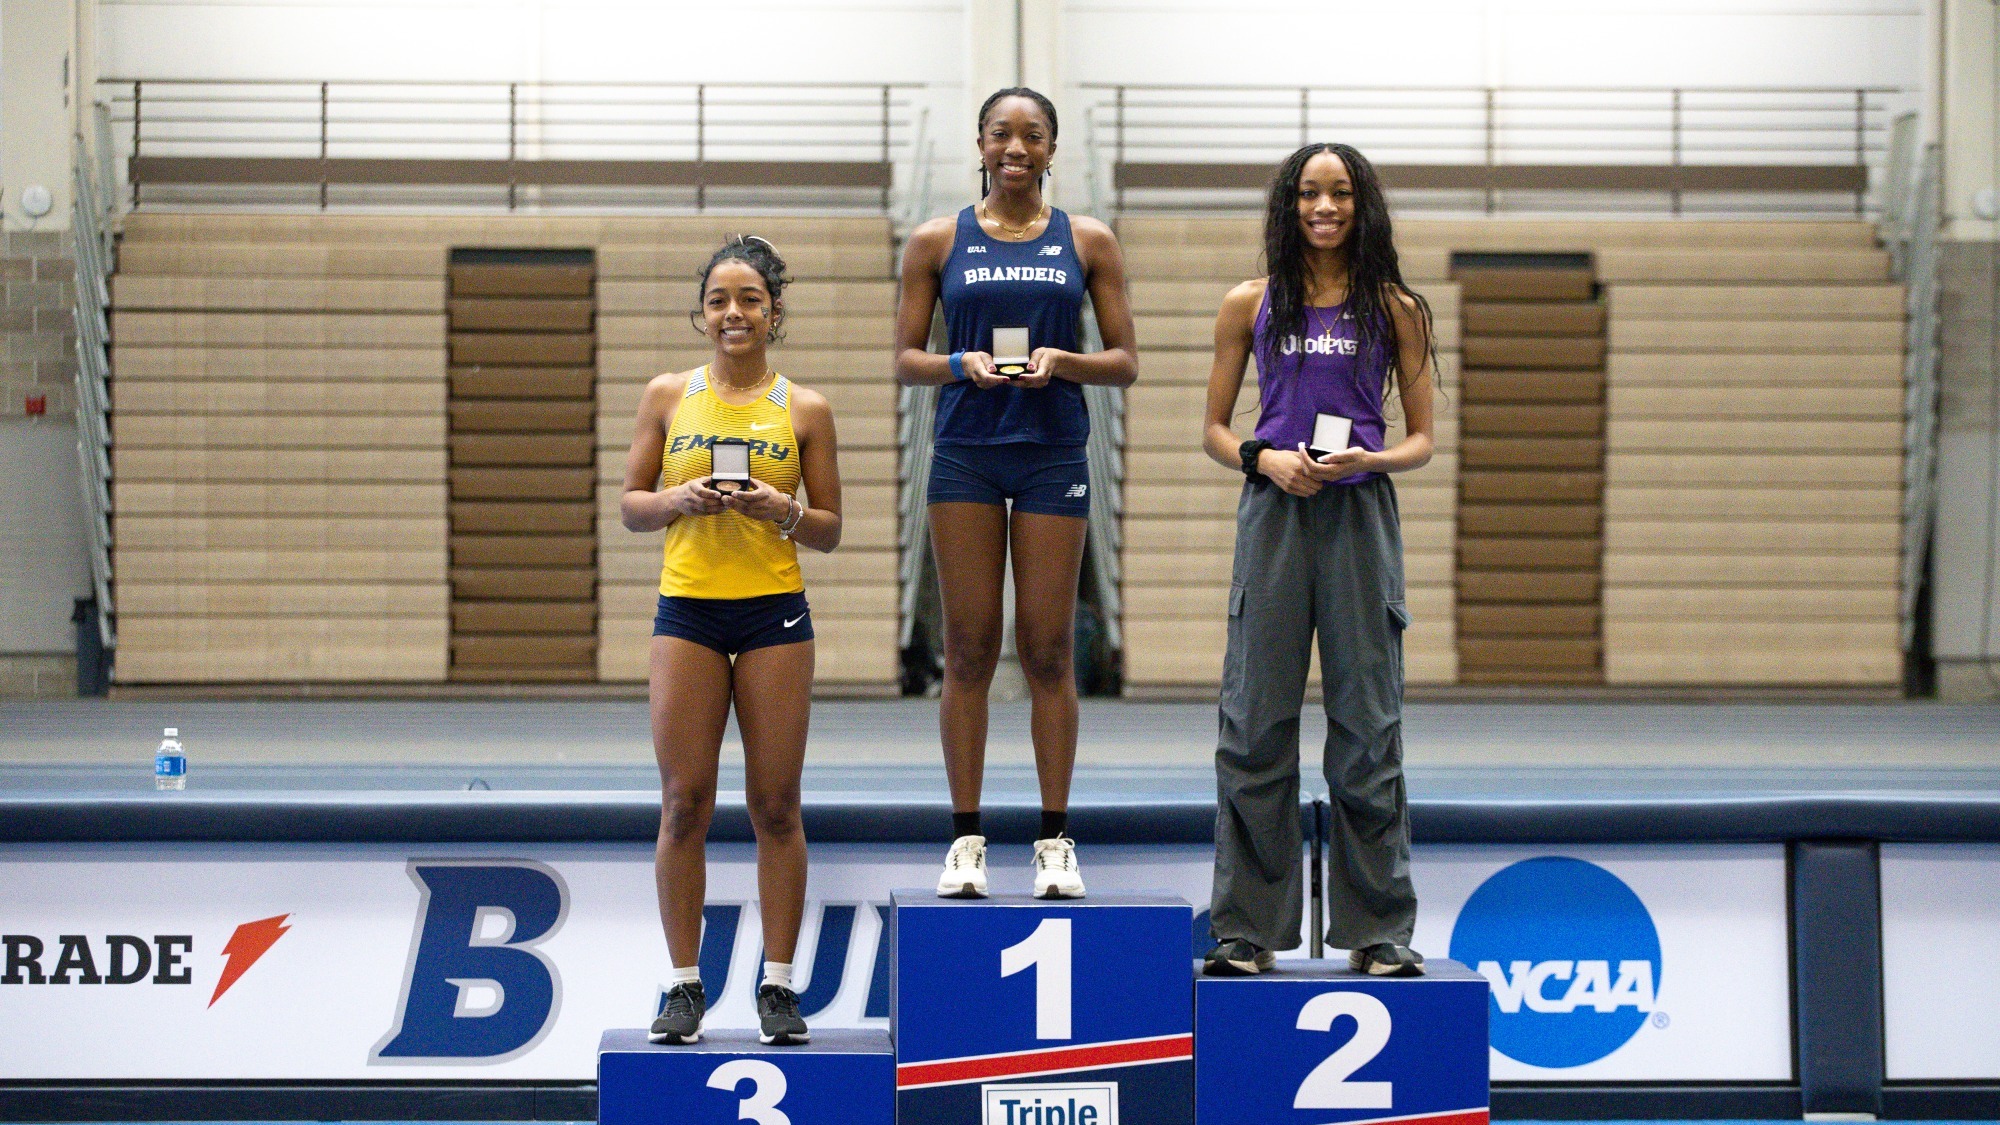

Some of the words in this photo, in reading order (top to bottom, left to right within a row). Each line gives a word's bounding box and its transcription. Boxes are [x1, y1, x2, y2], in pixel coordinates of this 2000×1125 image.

[964, 266, 1067, 285] BRANDEIS
[669, 435, 790, 461] EMRY
[0, 934, 193, 985] RADE
[366, 856, 571, 1067] B
[1000, 918, 1072, 1040] 1
[1476, 959, 1656, 1014] NCAA
[1293, 991, 1393, 1109] 2
[706, 1059, 792, 1125] 3
[999, 1098, 1098, 1125] Triple
